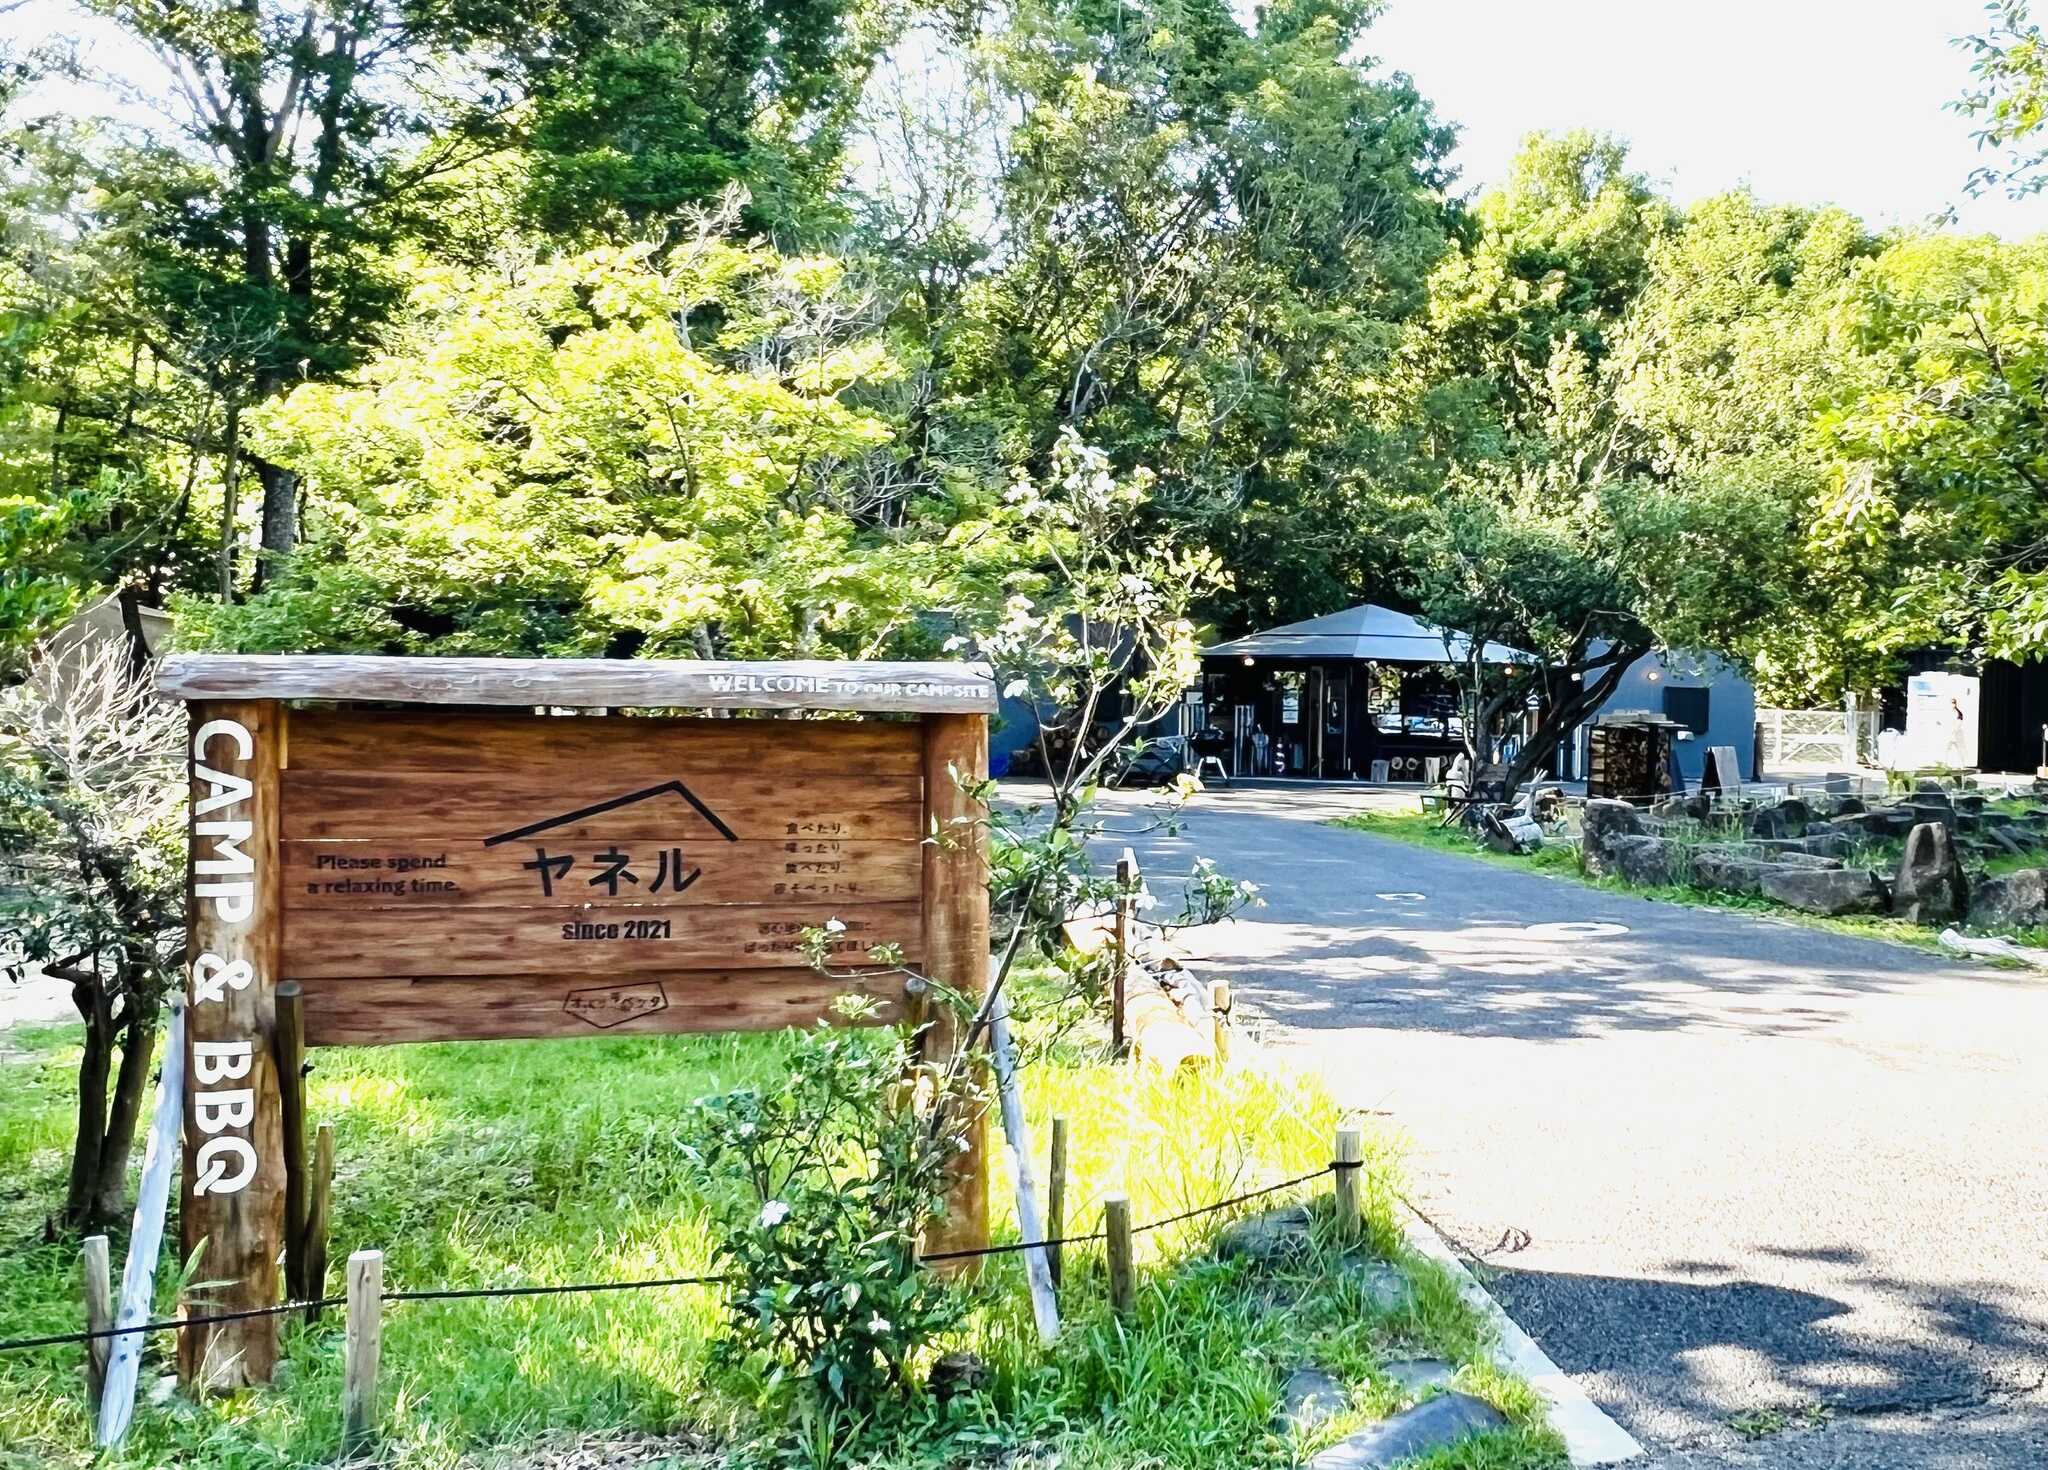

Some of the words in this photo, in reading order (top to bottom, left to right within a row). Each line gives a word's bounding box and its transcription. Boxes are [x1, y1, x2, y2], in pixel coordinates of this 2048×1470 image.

[708, 674, 830, 694] WELCOME
[834, 681, 860, 695] TO
[863, 682, 904, 697] OUR
[906, 684, 989, 699] CAMPSITE
[194, 718, 255, 924] CAMP
[317, 854, 382, 870] Please
[386, 854, 448, 873] spend
[522, 847, 702, 897] ヤネル
[306, 882, 319, 895] a
[324, 877, 406, 896] relaxing
[561, 919, 620, 940] since
[623, 919, 672, 940] 2021
[193, 951, 253, 1006] &
[193, 1040, 258, 1196] BBQ
